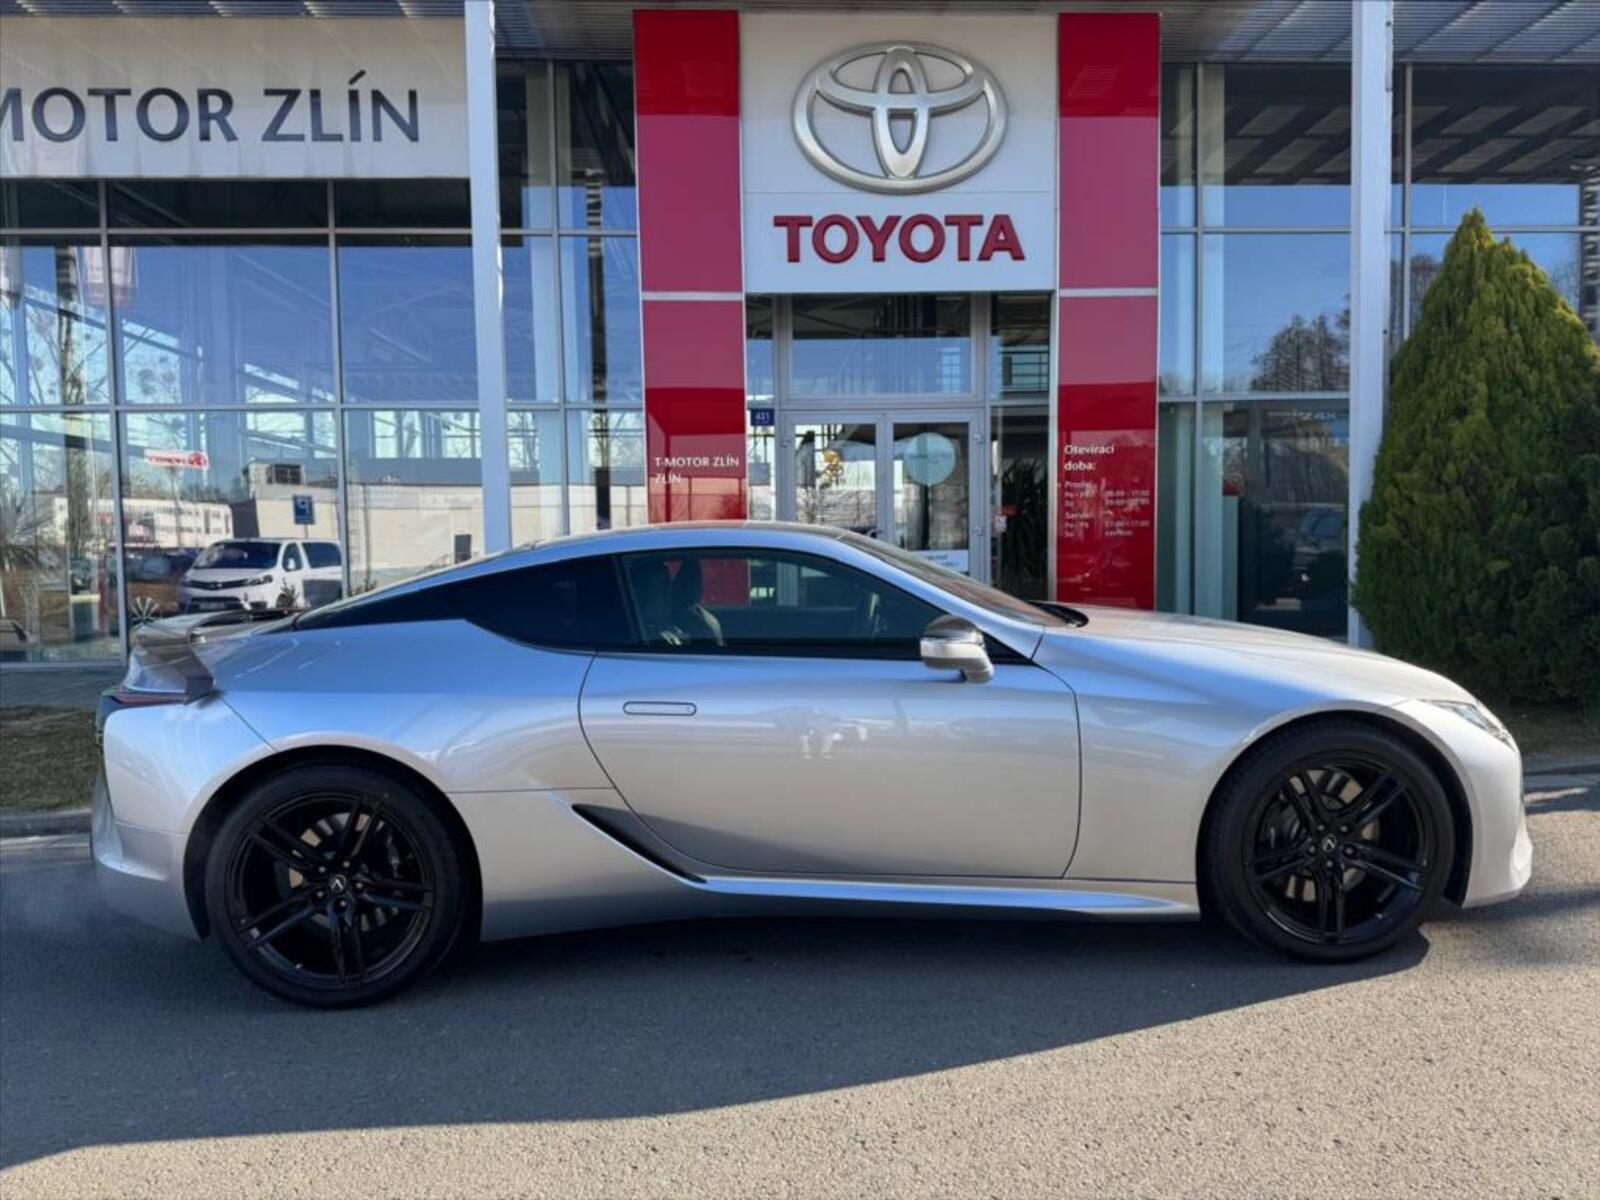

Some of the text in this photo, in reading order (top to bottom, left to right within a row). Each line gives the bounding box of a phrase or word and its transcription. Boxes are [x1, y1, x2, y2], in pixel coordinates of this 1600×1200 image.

[261, 70, 419, 142] ZLÍN
[773, 213, 1025, 264] TOYOTA
[655, 453, 740, 468] T-MOTOR ZLÍN
